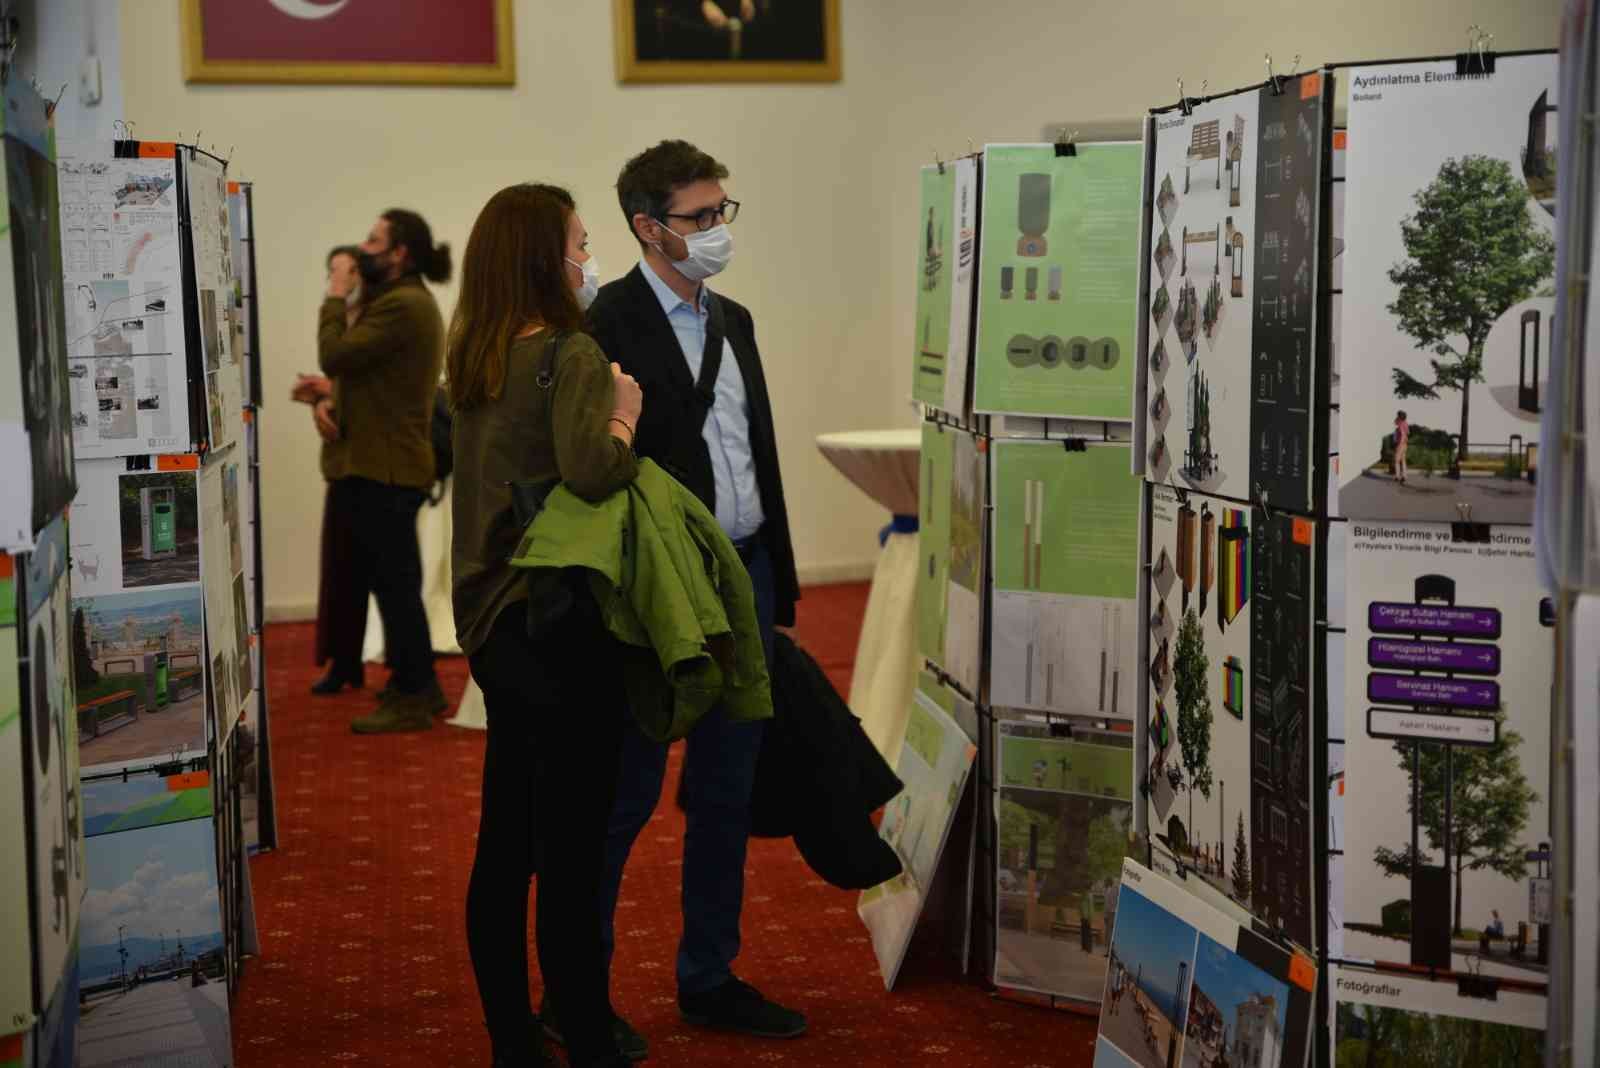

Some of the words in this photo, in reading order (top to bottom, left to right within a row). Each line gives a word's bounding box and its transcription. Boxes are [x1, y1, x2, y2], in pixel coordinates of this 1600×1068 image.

[1353, 72, 1421, 88] Aydınlatma
[1353, 526, 1432, 540] Bilgilendirme
[1435, 531, 1450, 541] ve
[1336, 977, 1401, 997] Fotoğraflar
